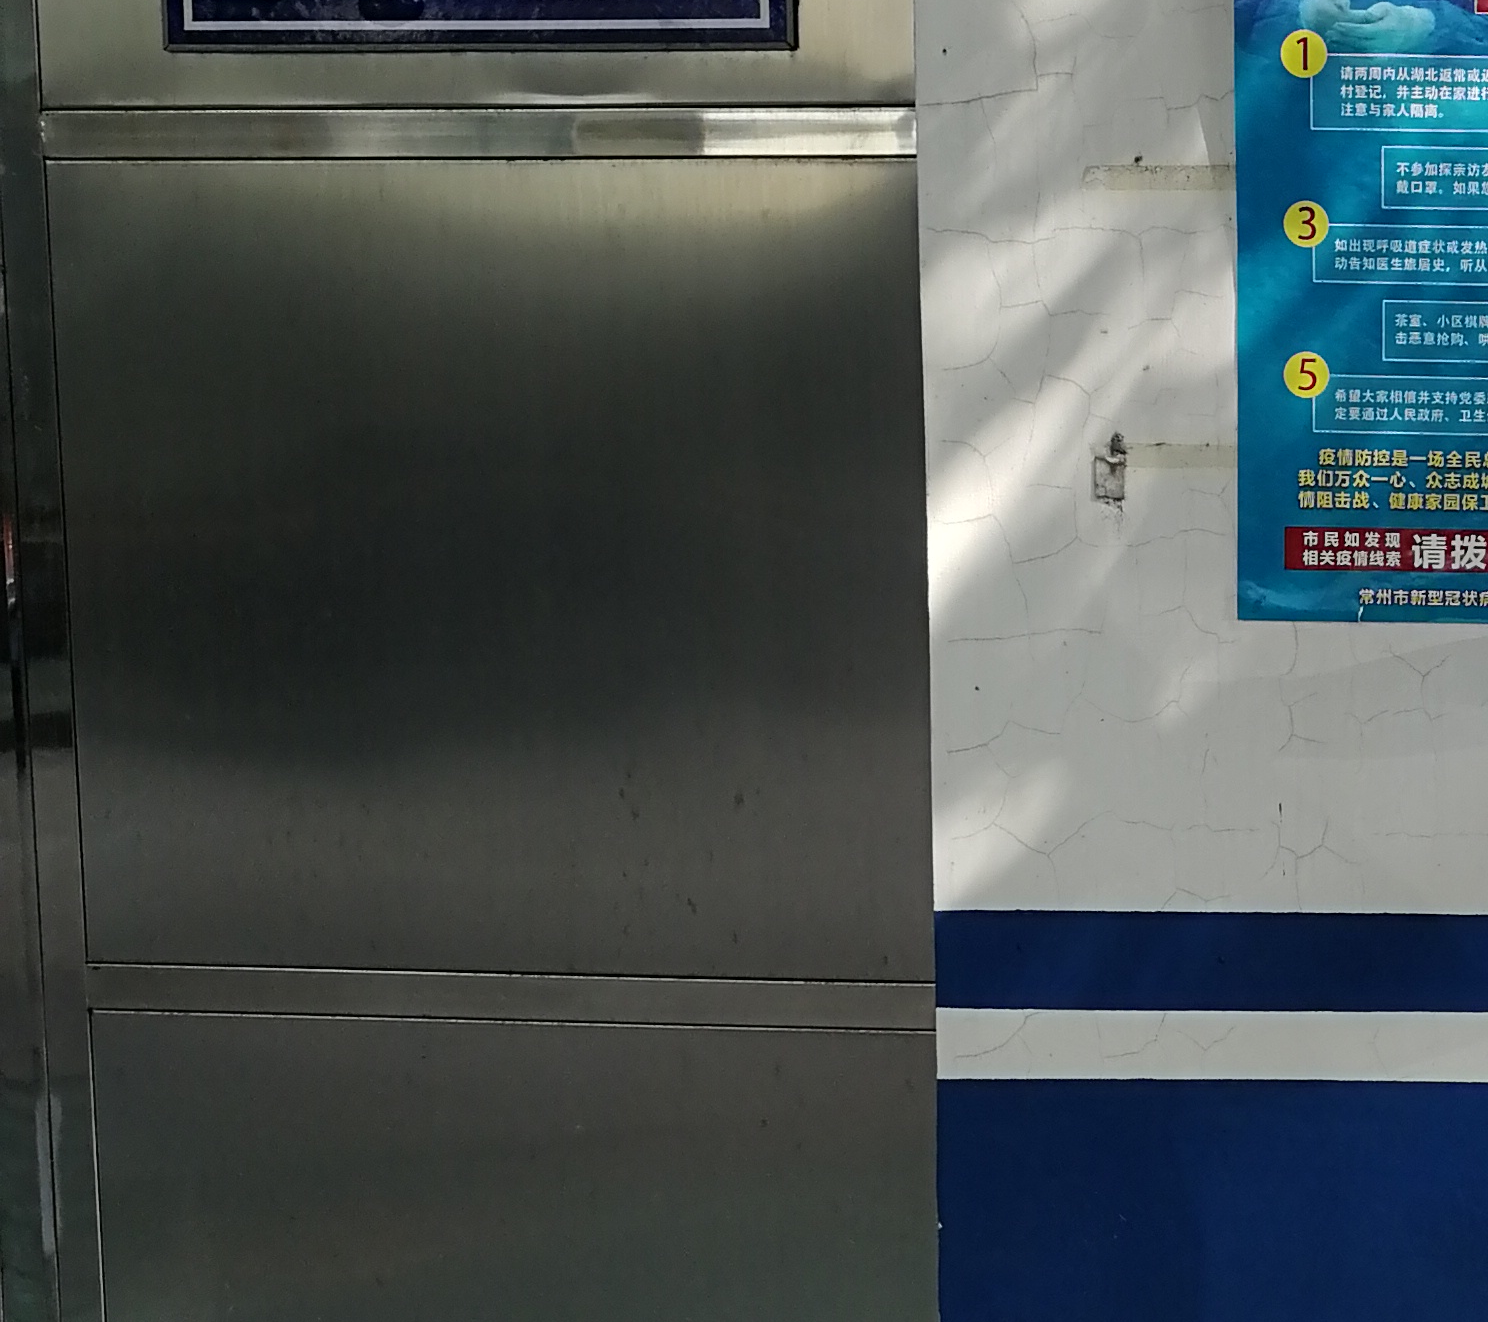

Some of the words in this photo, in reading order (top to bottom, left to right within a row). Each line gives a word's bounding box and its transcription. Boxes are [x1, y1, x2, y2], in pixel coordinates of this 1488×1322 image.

[1297, 37, 1309, 71] 1
[1340, 103, 1444, 119] 注意与家人隔离。
[1298, 206, 1317, 240] 3
[1299, 358, 1317, 392] 5
[1303, 531, 1401, 548] 市民如发现
[1303, 550, 1401, 567] 相关疫情线索
